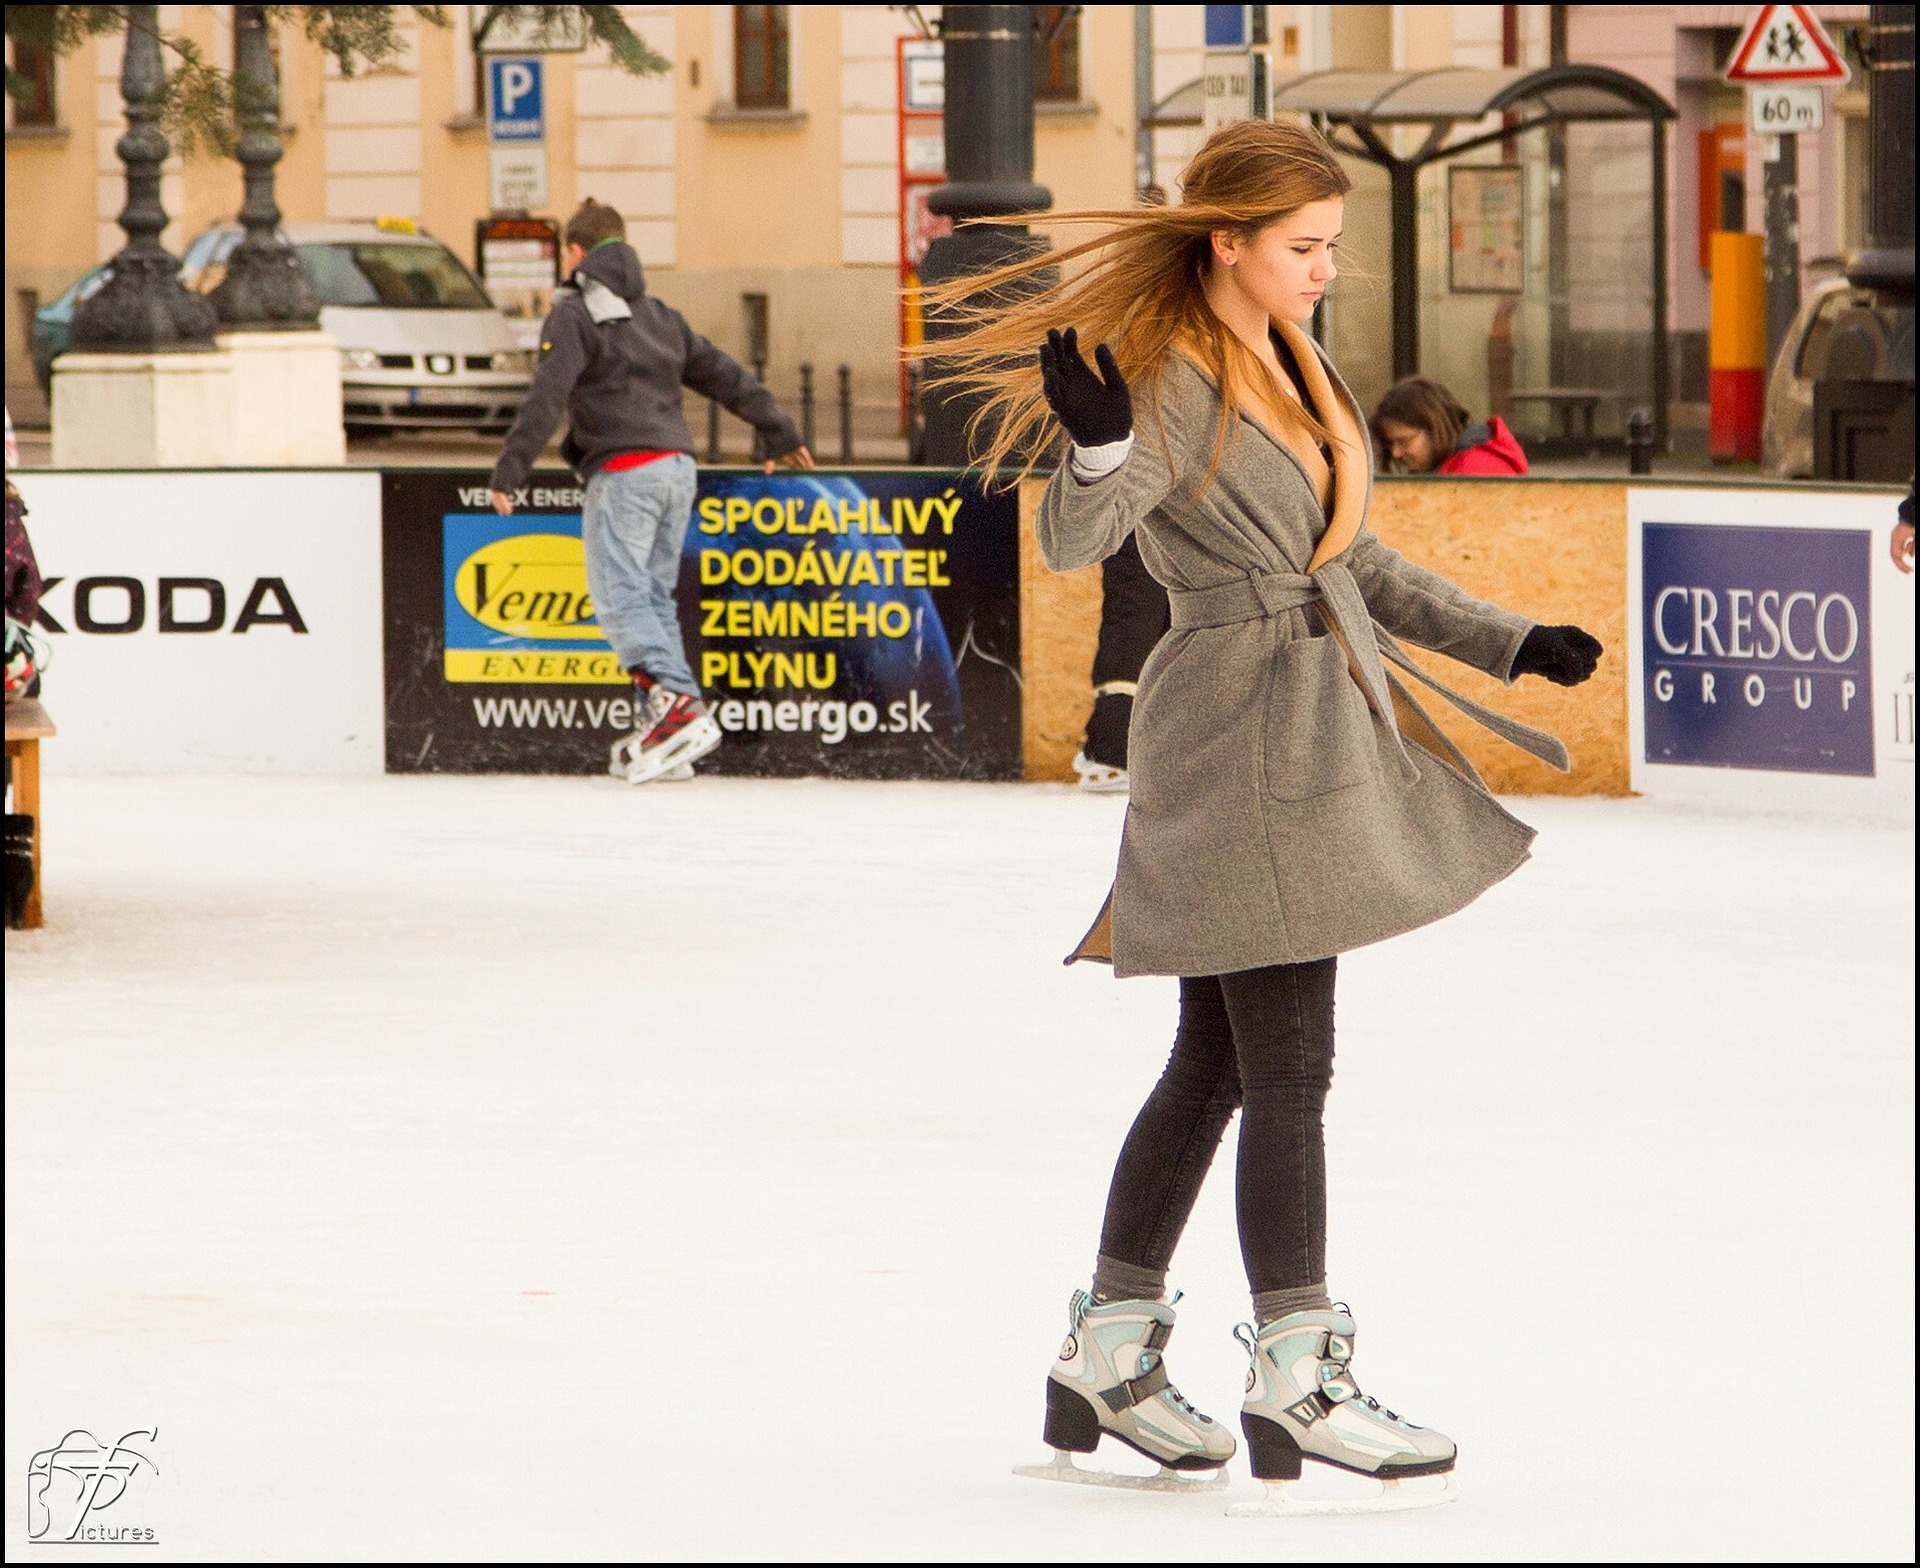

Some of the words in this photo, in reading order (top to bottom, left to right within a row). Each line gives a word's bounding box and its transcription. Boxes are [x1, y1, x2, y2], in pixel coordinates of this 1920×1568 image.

[502, 64, 534, 115] P
[1763, 97, 1791, 122] 60
[1797, 106, 1813, 121] m
[698, 487, 963, 535] SPOĽAHLIVÝ
[700, 539, 951, 587] DODÁVATEĽ
[700, 591, 912, 639] ZEMNÉHO
[1653, 586, 1859, 664] CRESCO
[481, 656, 628, 678] ENERG
[702, 651, 837, 689] PLYNU
[1654, 669, 1857, 711] GROUP
